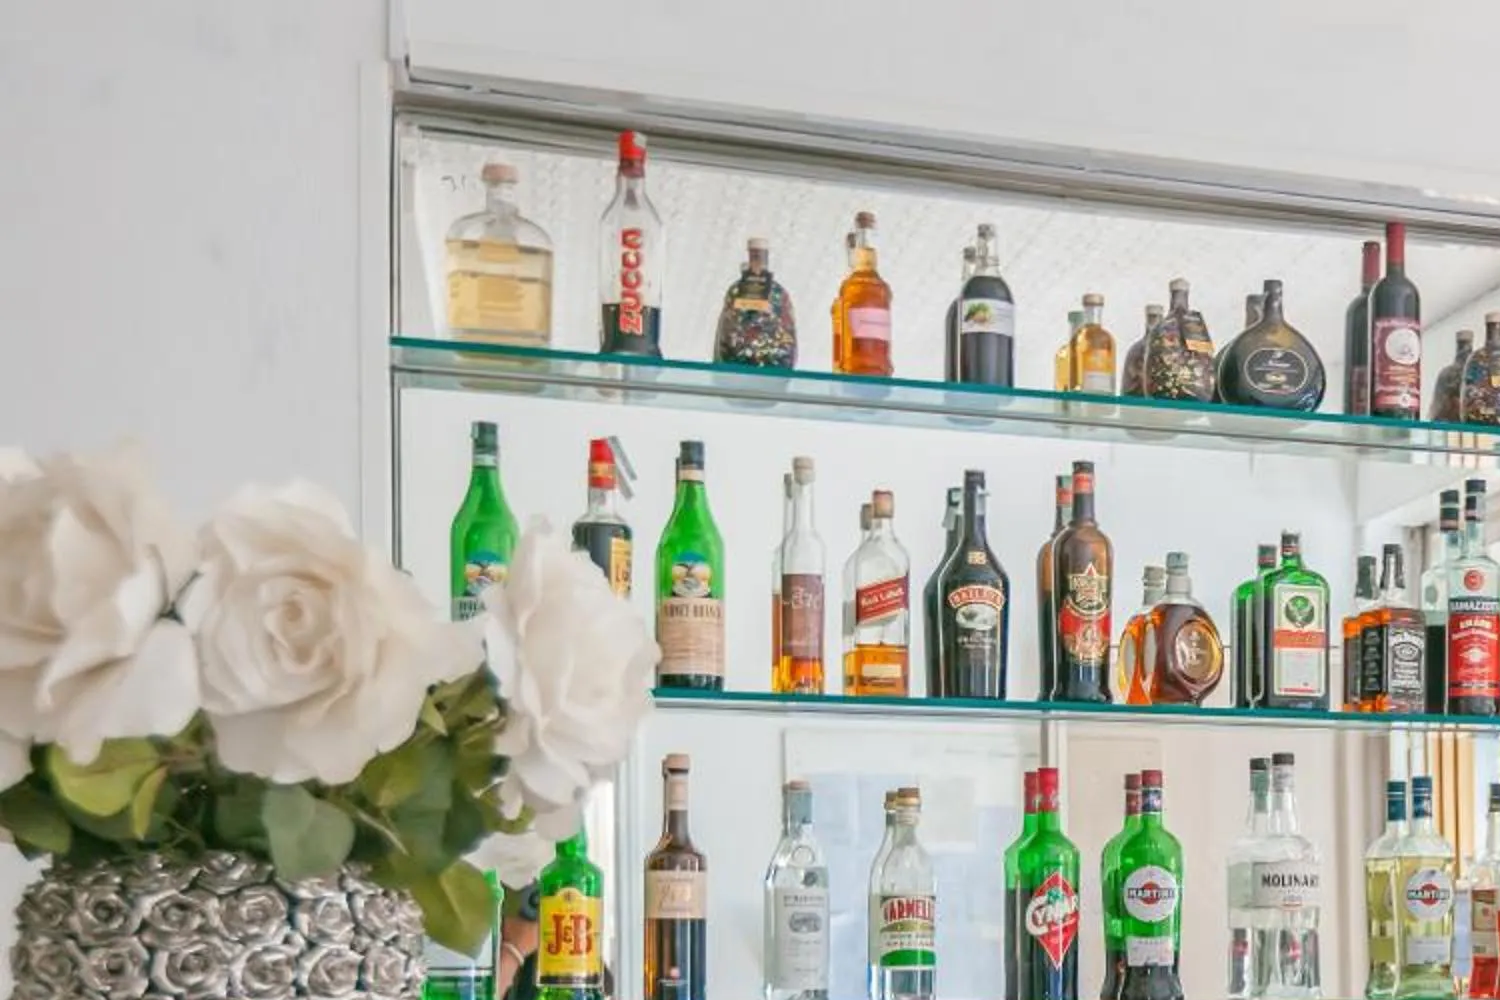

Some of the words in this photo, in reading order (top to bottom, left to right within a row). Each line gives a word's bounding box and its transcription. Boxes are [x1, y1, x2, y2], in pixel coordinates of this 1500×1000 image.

[620, 228, 643, 336] ZUCCA
[1128, 888, 1174, 899] MARTINI
[1407, 890, 1450, 900] MARTINI
[547, 912, 592, 955] J&B
